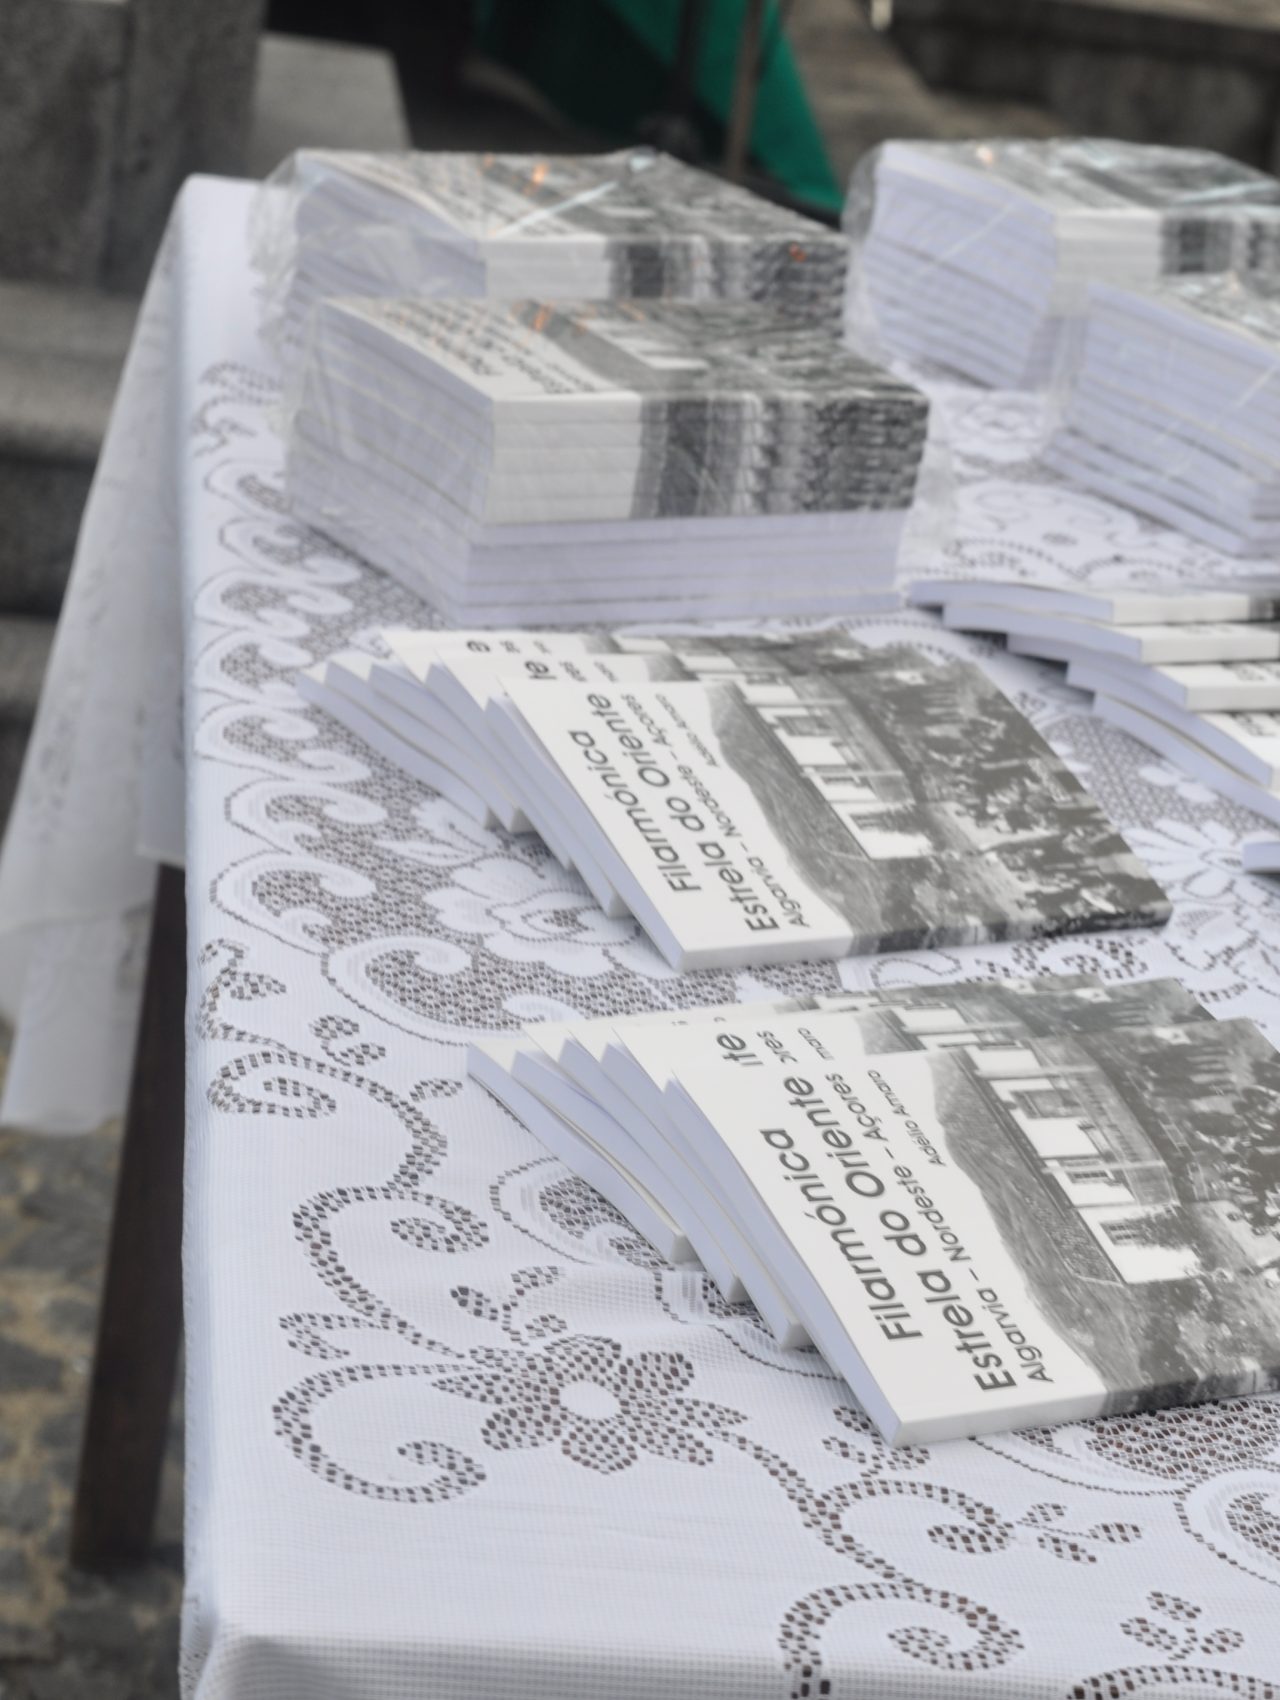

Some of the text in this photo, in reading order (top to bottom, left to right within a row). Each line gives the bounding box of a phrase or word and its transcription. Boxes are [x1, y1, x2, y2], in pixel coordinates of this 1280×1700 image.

[621, 693, 672, 747] Açores
[568, 729, 702, 892] Filarmónica
[587, 692, 781, 931] Estrela do Oriente
[677, 764, 742, 838] Nordeste
[746, 856, 811, 928] Algarvia
[825, 1072, 889, 1142] Açores
[867, 1070, 947, 1167] Adélio Amaro
[759, 1127, 924, 1341] Filarmónica
[783, 1076, 1018, 1392] Estrela do Oriente
[893, 1165, 972, 1263] Nordeste
[976, 1287, 1054, 1383] Algarvia
